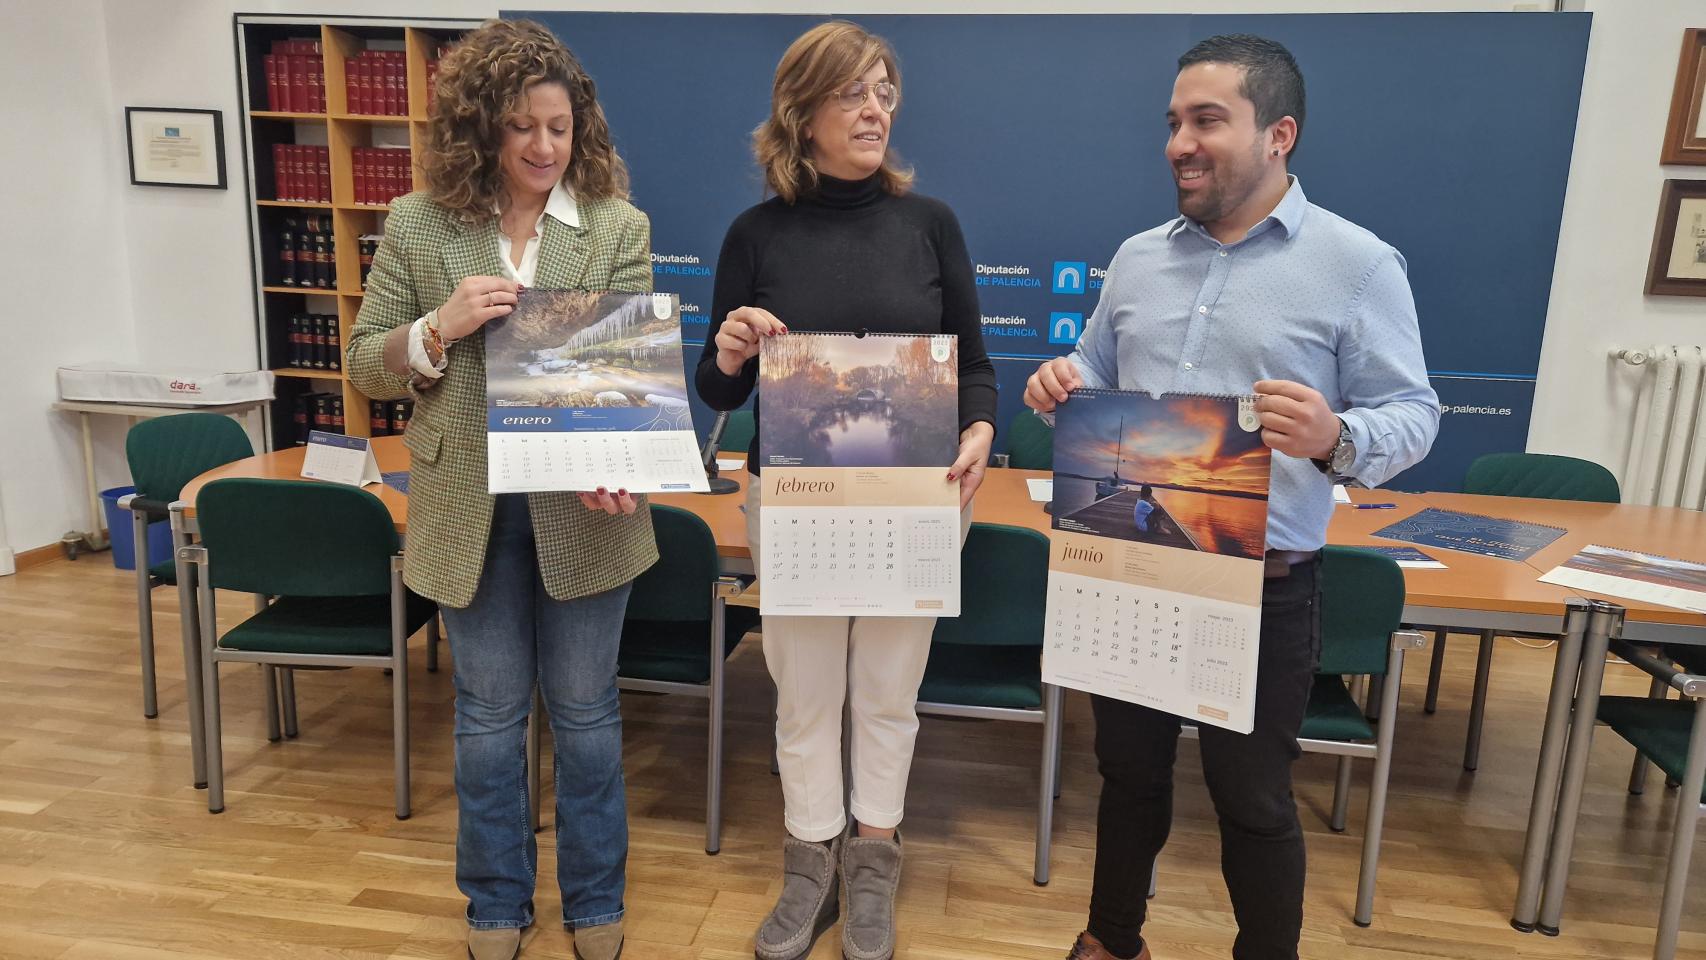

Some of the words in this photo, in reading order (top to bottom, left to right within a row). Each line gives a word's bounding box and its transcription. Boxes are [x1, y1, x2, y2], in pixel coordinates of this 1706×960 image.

[650, 253, 699, 264] Diputación
[665, 266, 711, 276] PALENCIA
[976, 264, 1029, 275] Diputación
[976, 277, 990, 286] DE
[992, 277, 1041, 288] PALENCIA
[981, 314, 1026, 326] iputación
[988, 328, 1038, 337] PALENCIA
[170, 380, 196, 390] dara
[1439, 404, 1512, 416] ip-palencia.es
[503, 416, 552, 425] enero
[775, 477, 835, 496] febrero
[1062, 542, 1103, 564] junio
